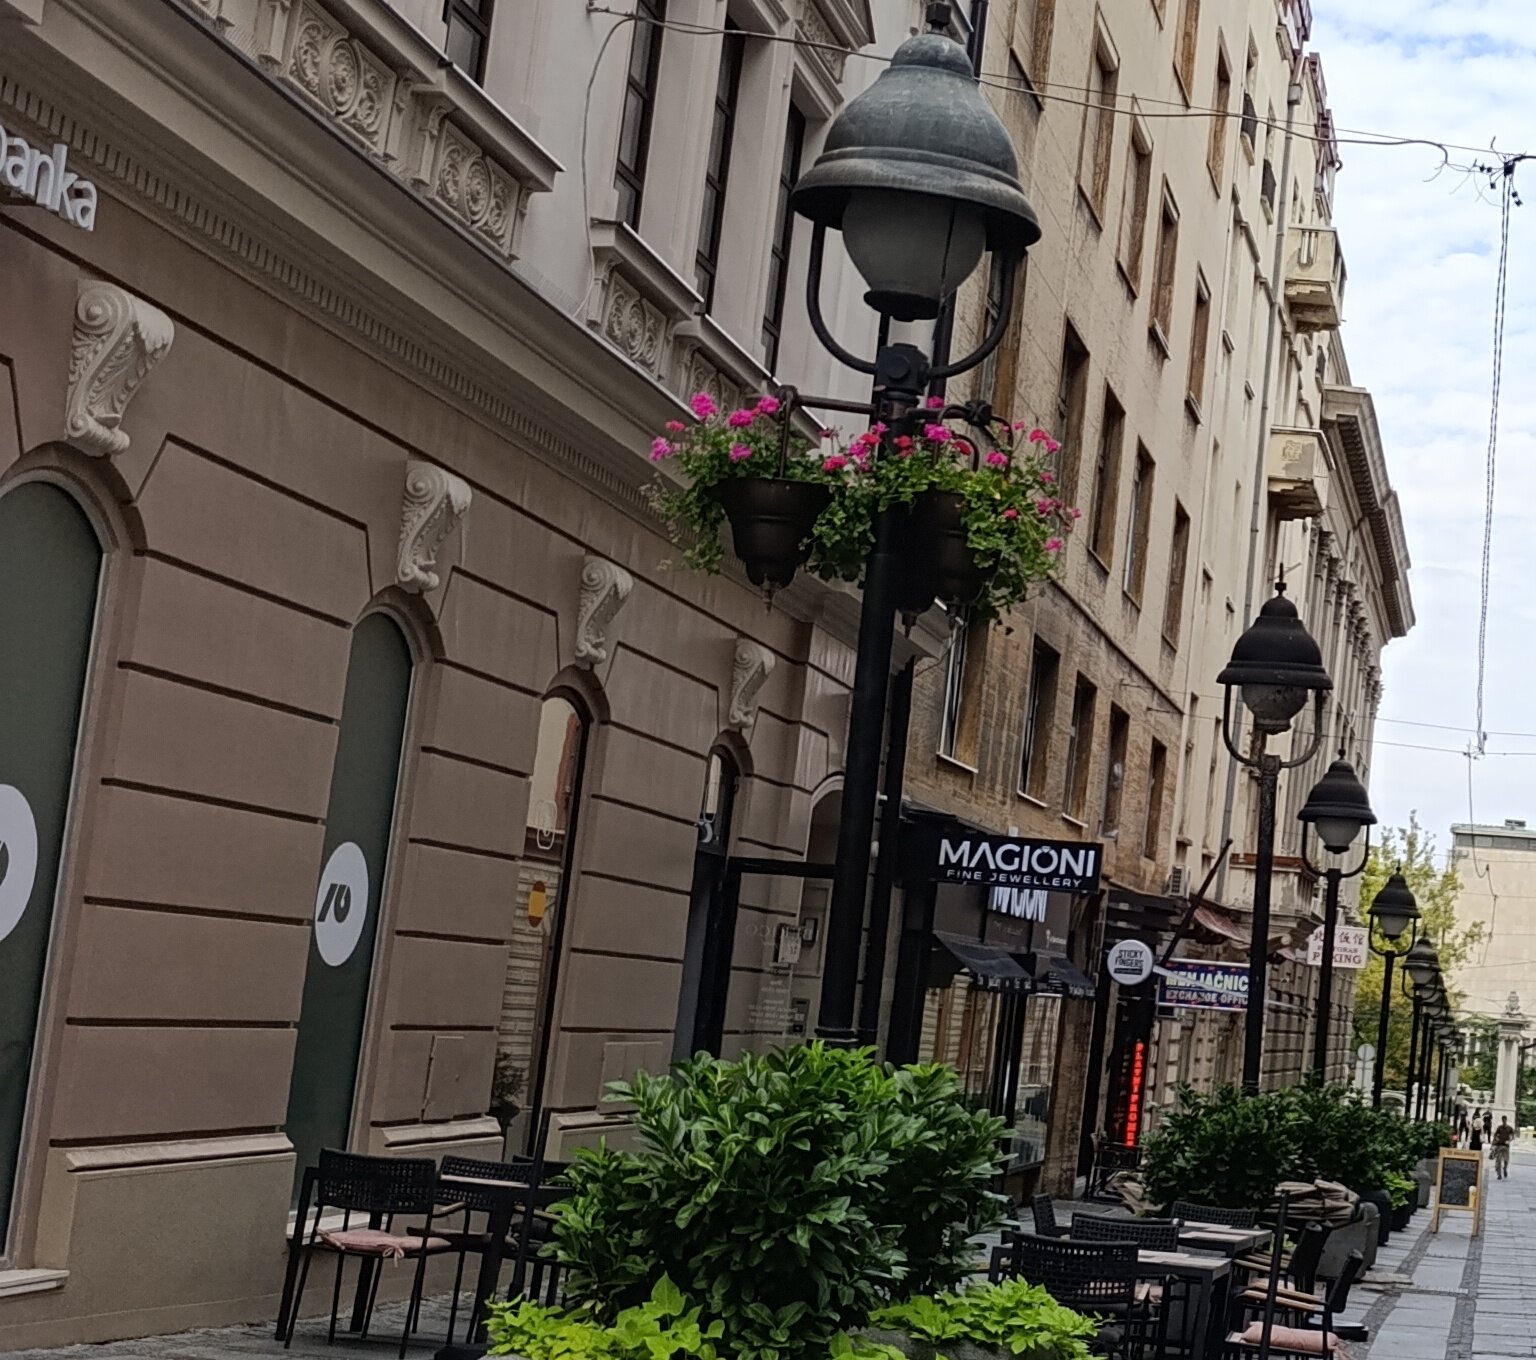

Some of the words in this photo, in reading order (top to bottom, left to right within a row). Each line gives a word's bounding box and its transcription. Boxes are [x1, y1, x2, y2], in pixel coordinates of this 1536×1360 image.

[938, 838, 1095, 877] MAGIONI
[946, 869, 982, 880] FINE
[989, 872, 1082, 888] JEWELLERY
[1312, 952, 1361, 965] PKING
[1166, 970, 1249, 991] MENJAČNIC
[1220, 992, 1248, 1005] OFFIC
